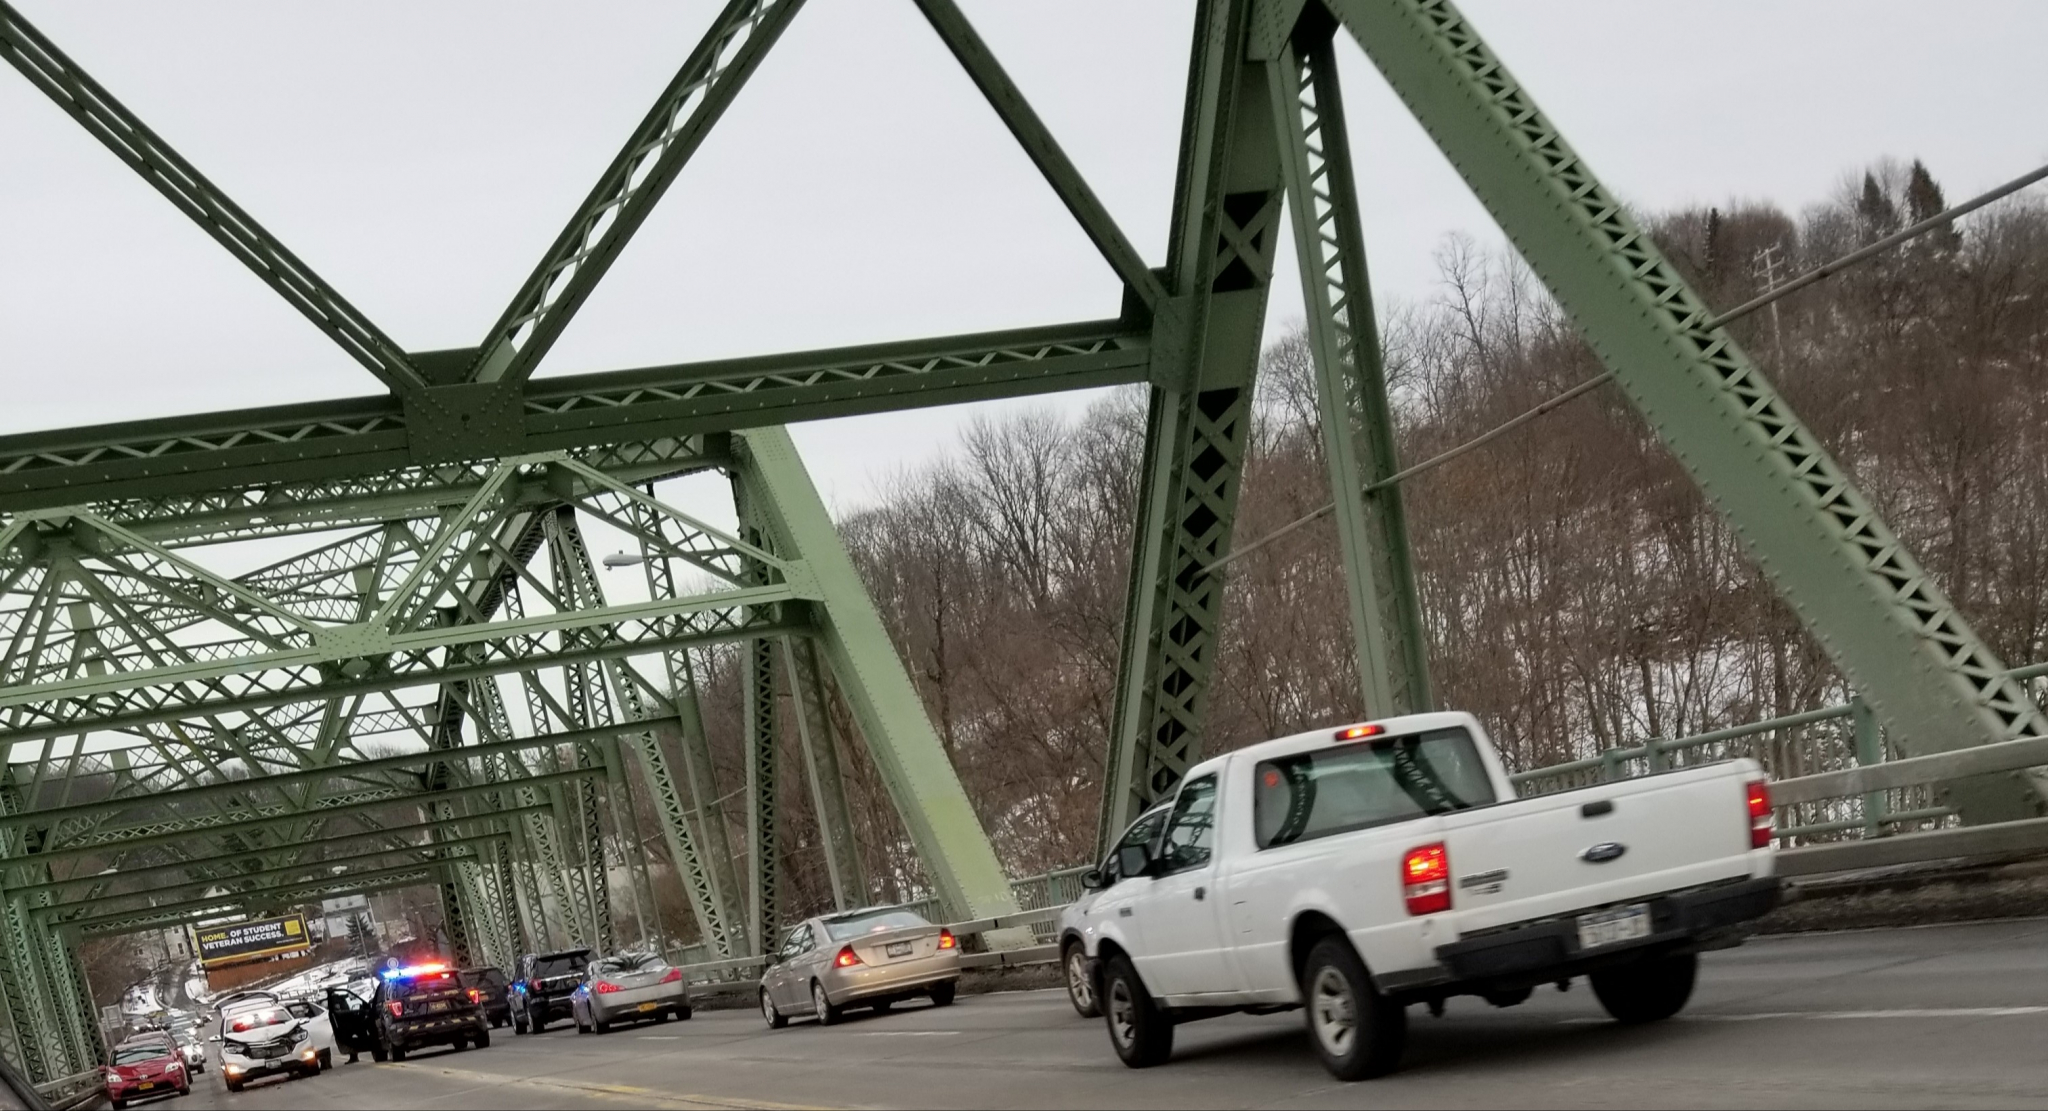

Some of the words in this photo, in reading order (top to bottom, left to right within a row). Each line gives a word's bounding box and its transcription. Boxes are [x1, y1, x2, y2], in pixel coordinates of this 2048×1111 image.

[202, 932, 229, 943] HOME.
[230, 928, 242, 938] OF
[243, 923, 282, 936] STUDENT
[203, 937, 243, 950] VETERAN
[244, 931, 284, 943] SUCCESS.
